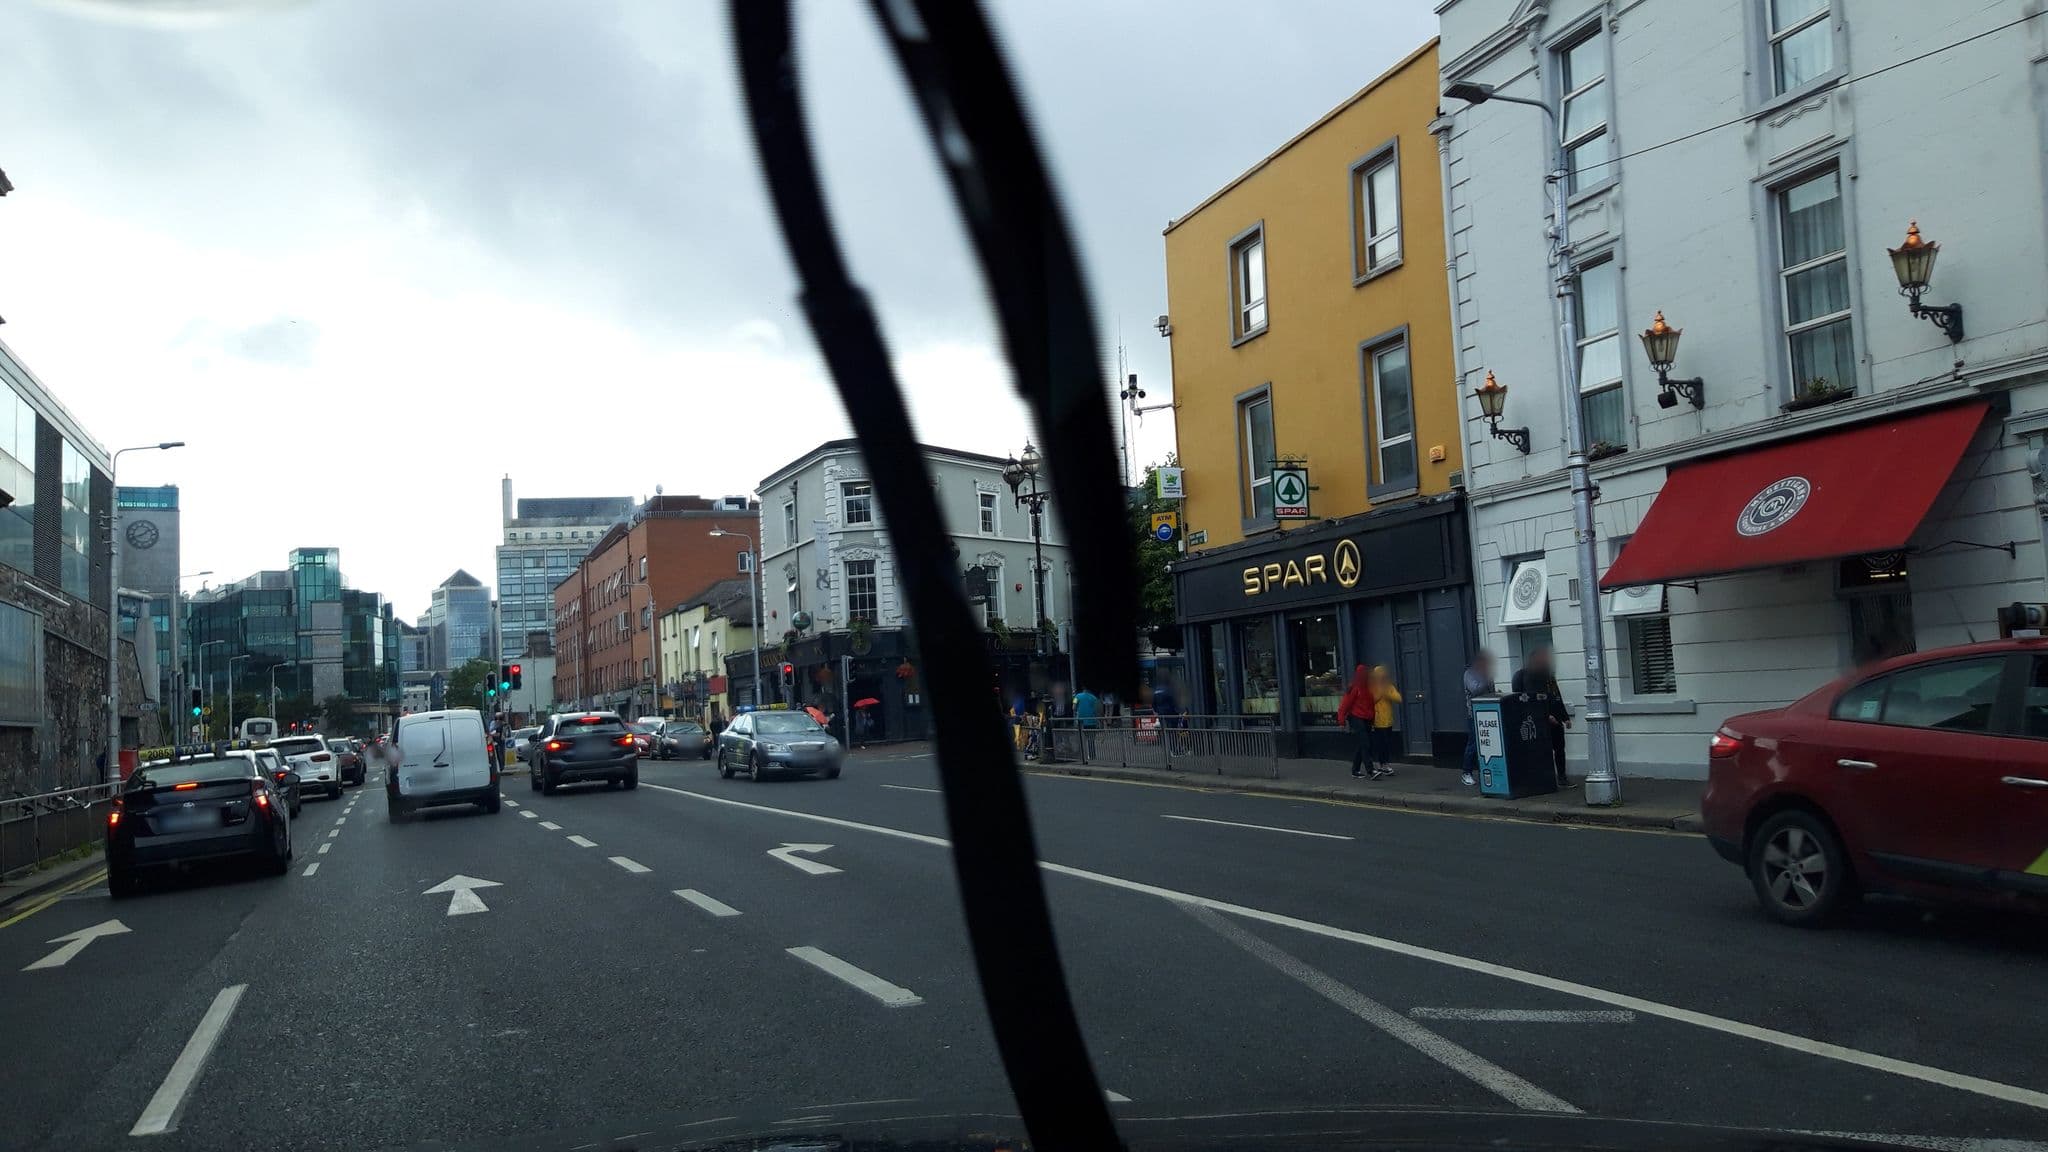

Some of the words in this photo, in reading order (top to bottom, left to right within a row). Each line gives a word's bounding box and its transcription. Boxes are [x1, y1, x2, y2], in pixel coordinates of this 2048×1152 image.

[1243, 554, 1327, 596] SPAR
[1479, 720, 1498, 728] PLEASE
[1480, 729, 1490, 737] USE
[181, 744, 207, 755] TAXI
